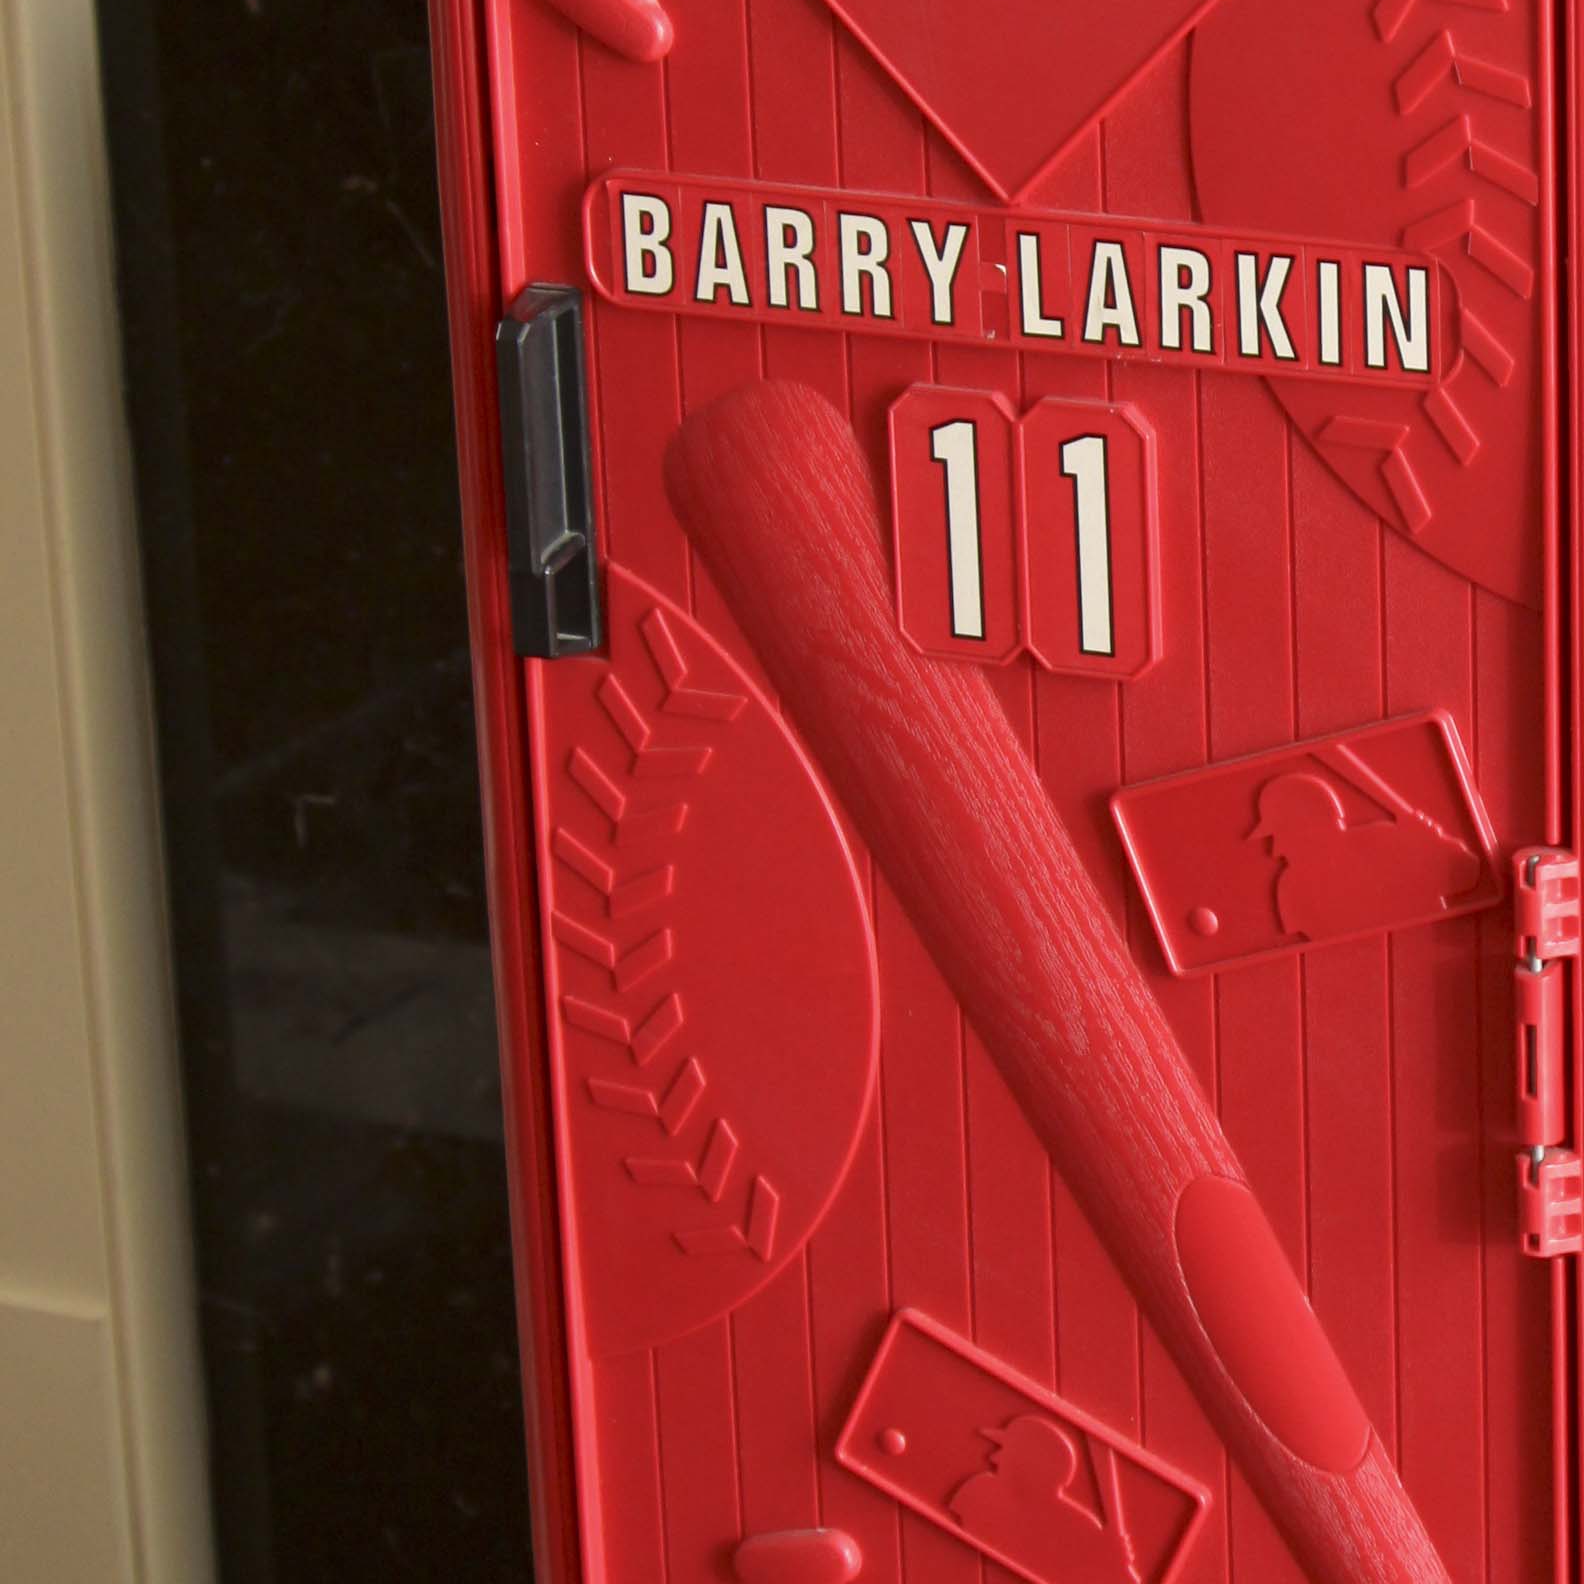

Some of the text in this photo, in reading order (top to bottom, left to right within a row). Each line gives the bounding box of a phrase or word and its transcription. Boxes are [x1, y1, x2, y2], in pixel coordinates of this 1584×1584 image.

[619, 191, 1433, 374] BARRY LARKIN
[928, 418, 1117, 658] 11
